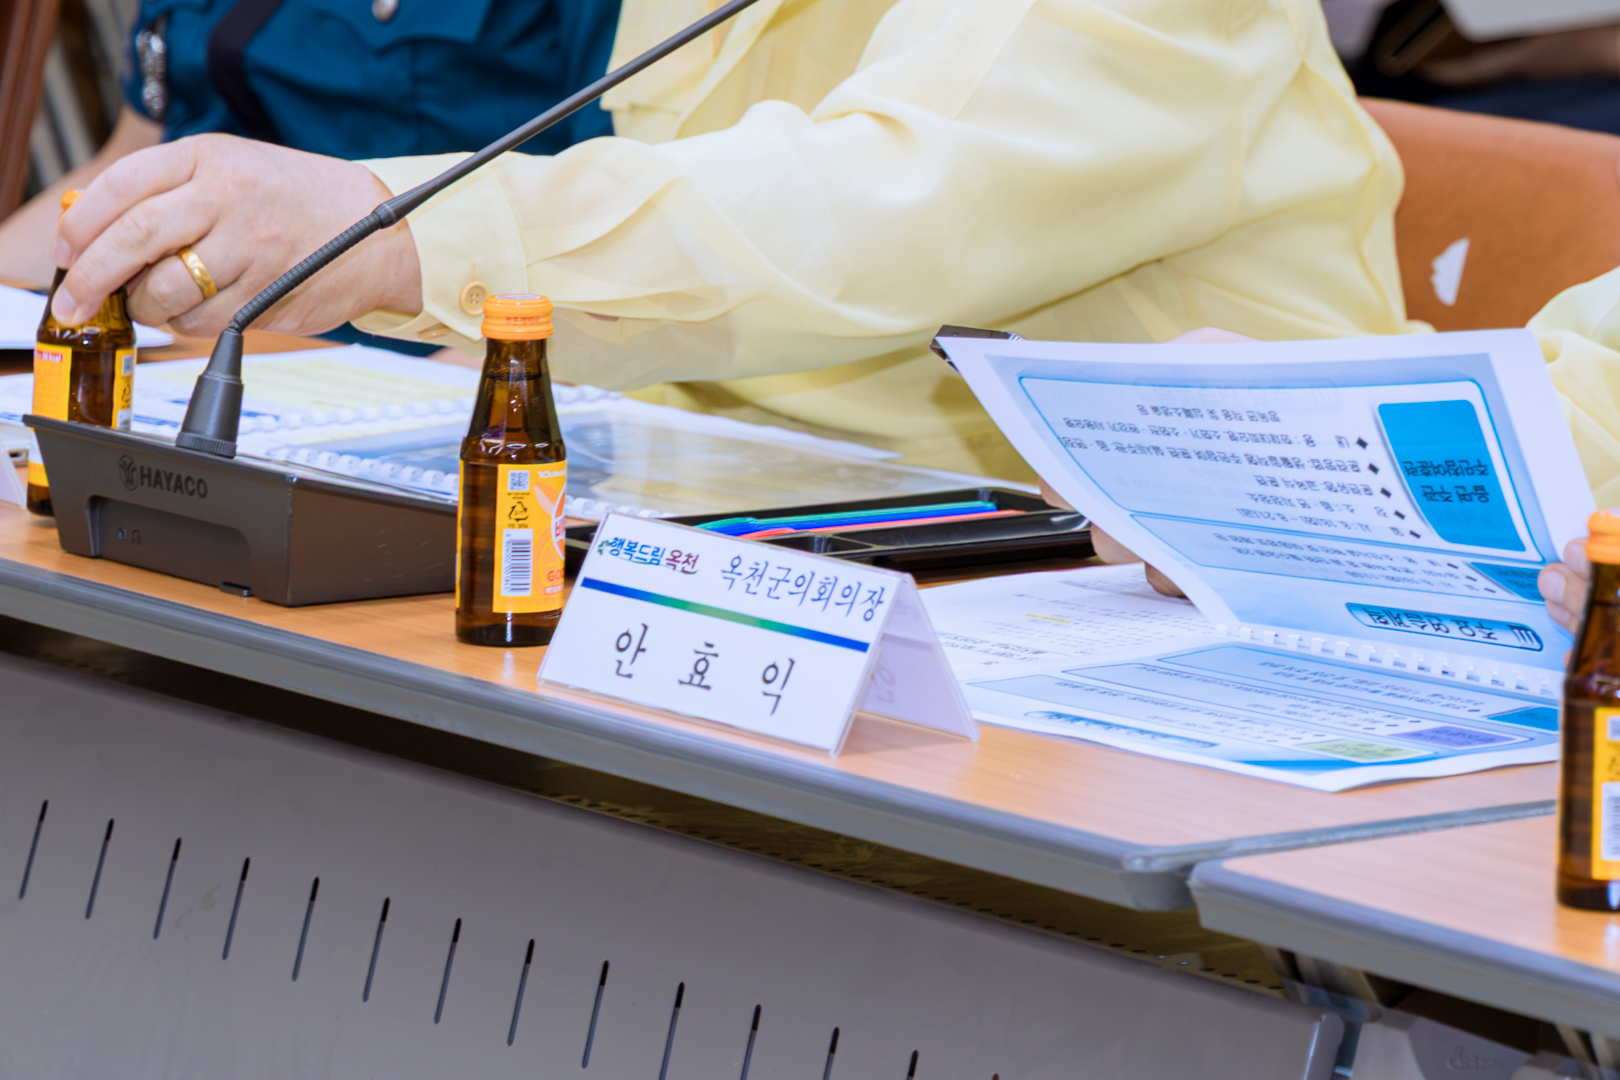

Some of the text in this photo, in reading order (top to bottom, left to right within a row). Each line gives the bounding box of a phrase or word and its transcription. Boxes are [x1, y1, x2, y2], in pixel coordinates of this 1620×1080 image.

[1402, 458, 1490, 477] 주민참여훈련
[139, 465, 208, 499] HAYACO
[1420, 484, 1490, 504] 읍면 주관
[609, 536, 700, 575] 행복드림 옥천
[721, 554, 886, 622] 옥천군의회의장
[1450, 618, 1498, 641] 주요
